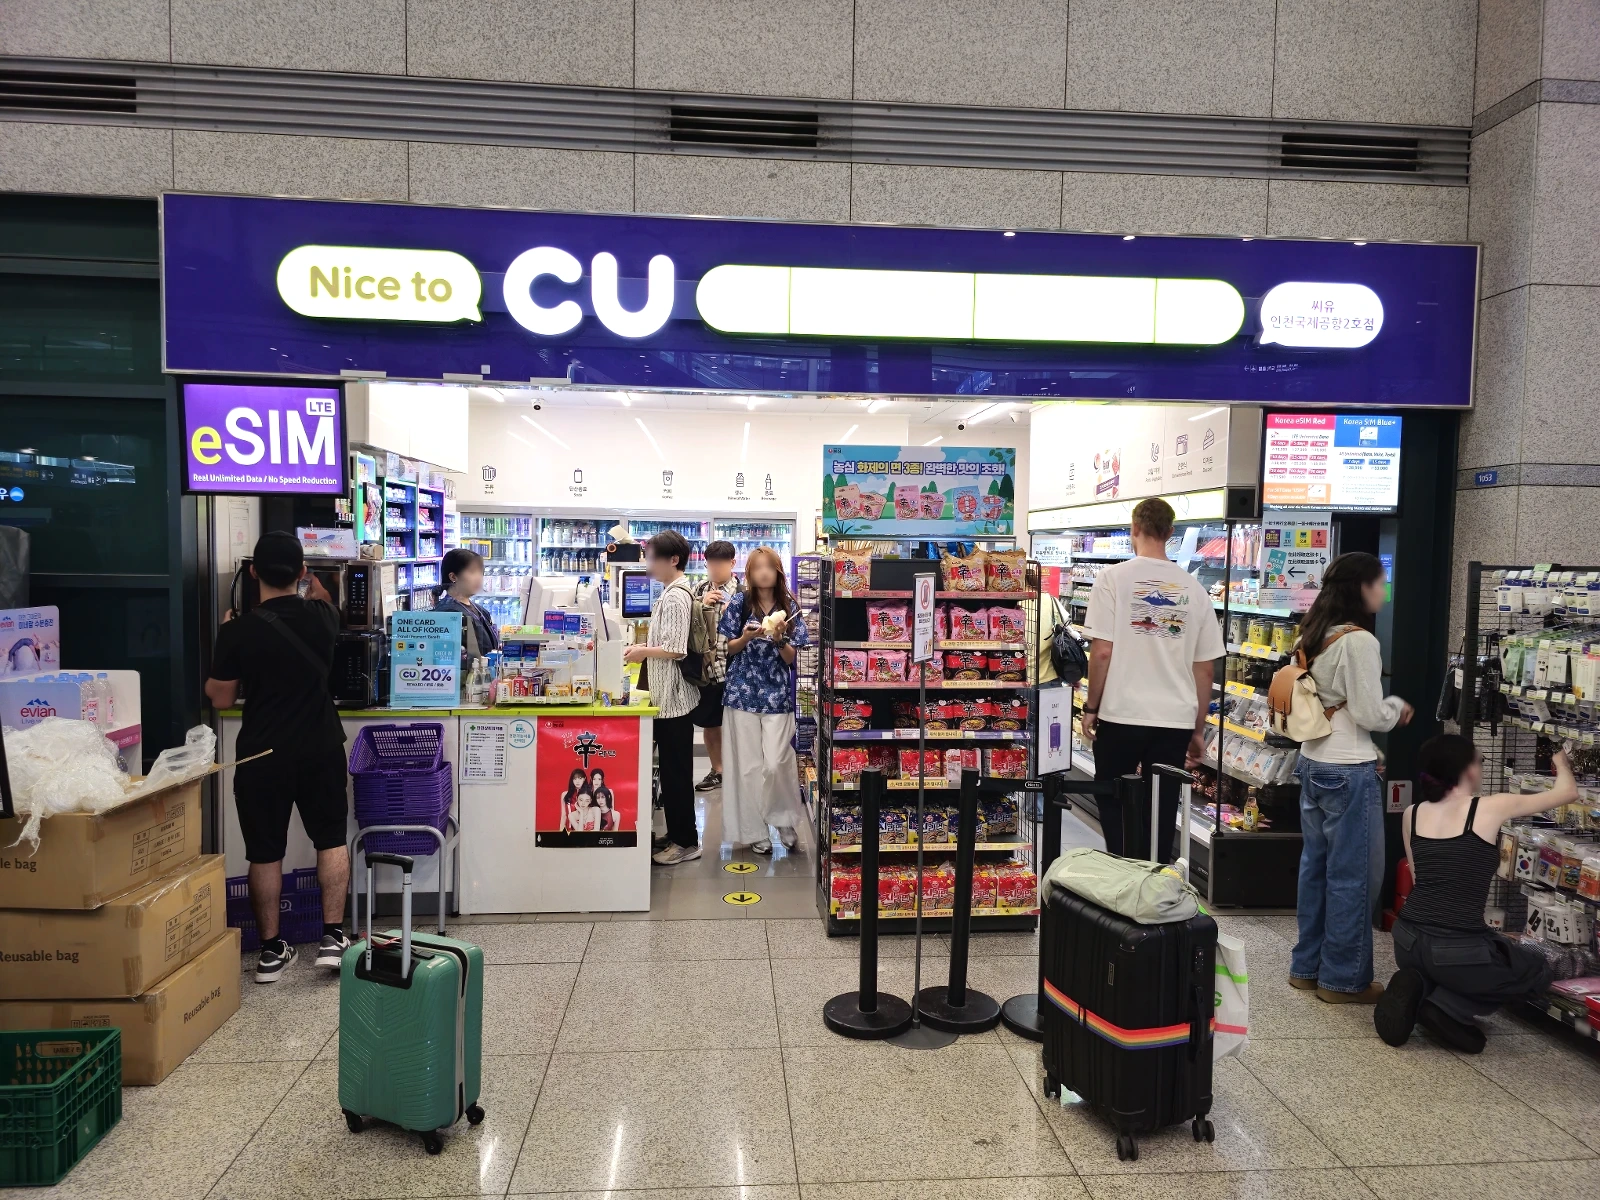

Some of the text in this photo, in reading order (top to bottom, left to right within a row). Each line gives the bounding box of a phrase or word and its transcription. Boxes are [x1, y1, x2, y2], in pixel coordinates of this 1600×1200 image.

[310, 265, 452, 303] Nice to
[503, 246, 674, 338] CU
[1312, 300, 1334, 313] 씨유
[1270, 316, 1374, 332] 인천국제공항2호점
[309, 402, 332, 412] LTE
[192, 406, 336, 466] eSIM
[833, 460, 1006, 476] 농심 화제의 면 3종! 완벽한 맛의 조화!
[194, 474, 208, 482] Real
[210, 474, 245, 484] Unlimited
[280, 476, 300, 486] Speed
[302, 477, 337, 485] Reduction
[1479, 474, 1493, 482] 1053
[958, 564, 971, 580] 辛
[997, 563, 1010, 580] 辛
[878, 611, 889, 628] 辛
[961, 614, 972, 630] 辛
[999, 615, 1010, 631] 辛
[877, 657, 888, 672] 辛
[422, 669, 452, 682] 20%
[20, 706, 56, 718] evian
[573, 731, 617, 770] 辛 라면
[14, 858, 37, 872] bag
[56, 950, 80, 965] bag
[184, 986, 221, 1024] Reusable bag
